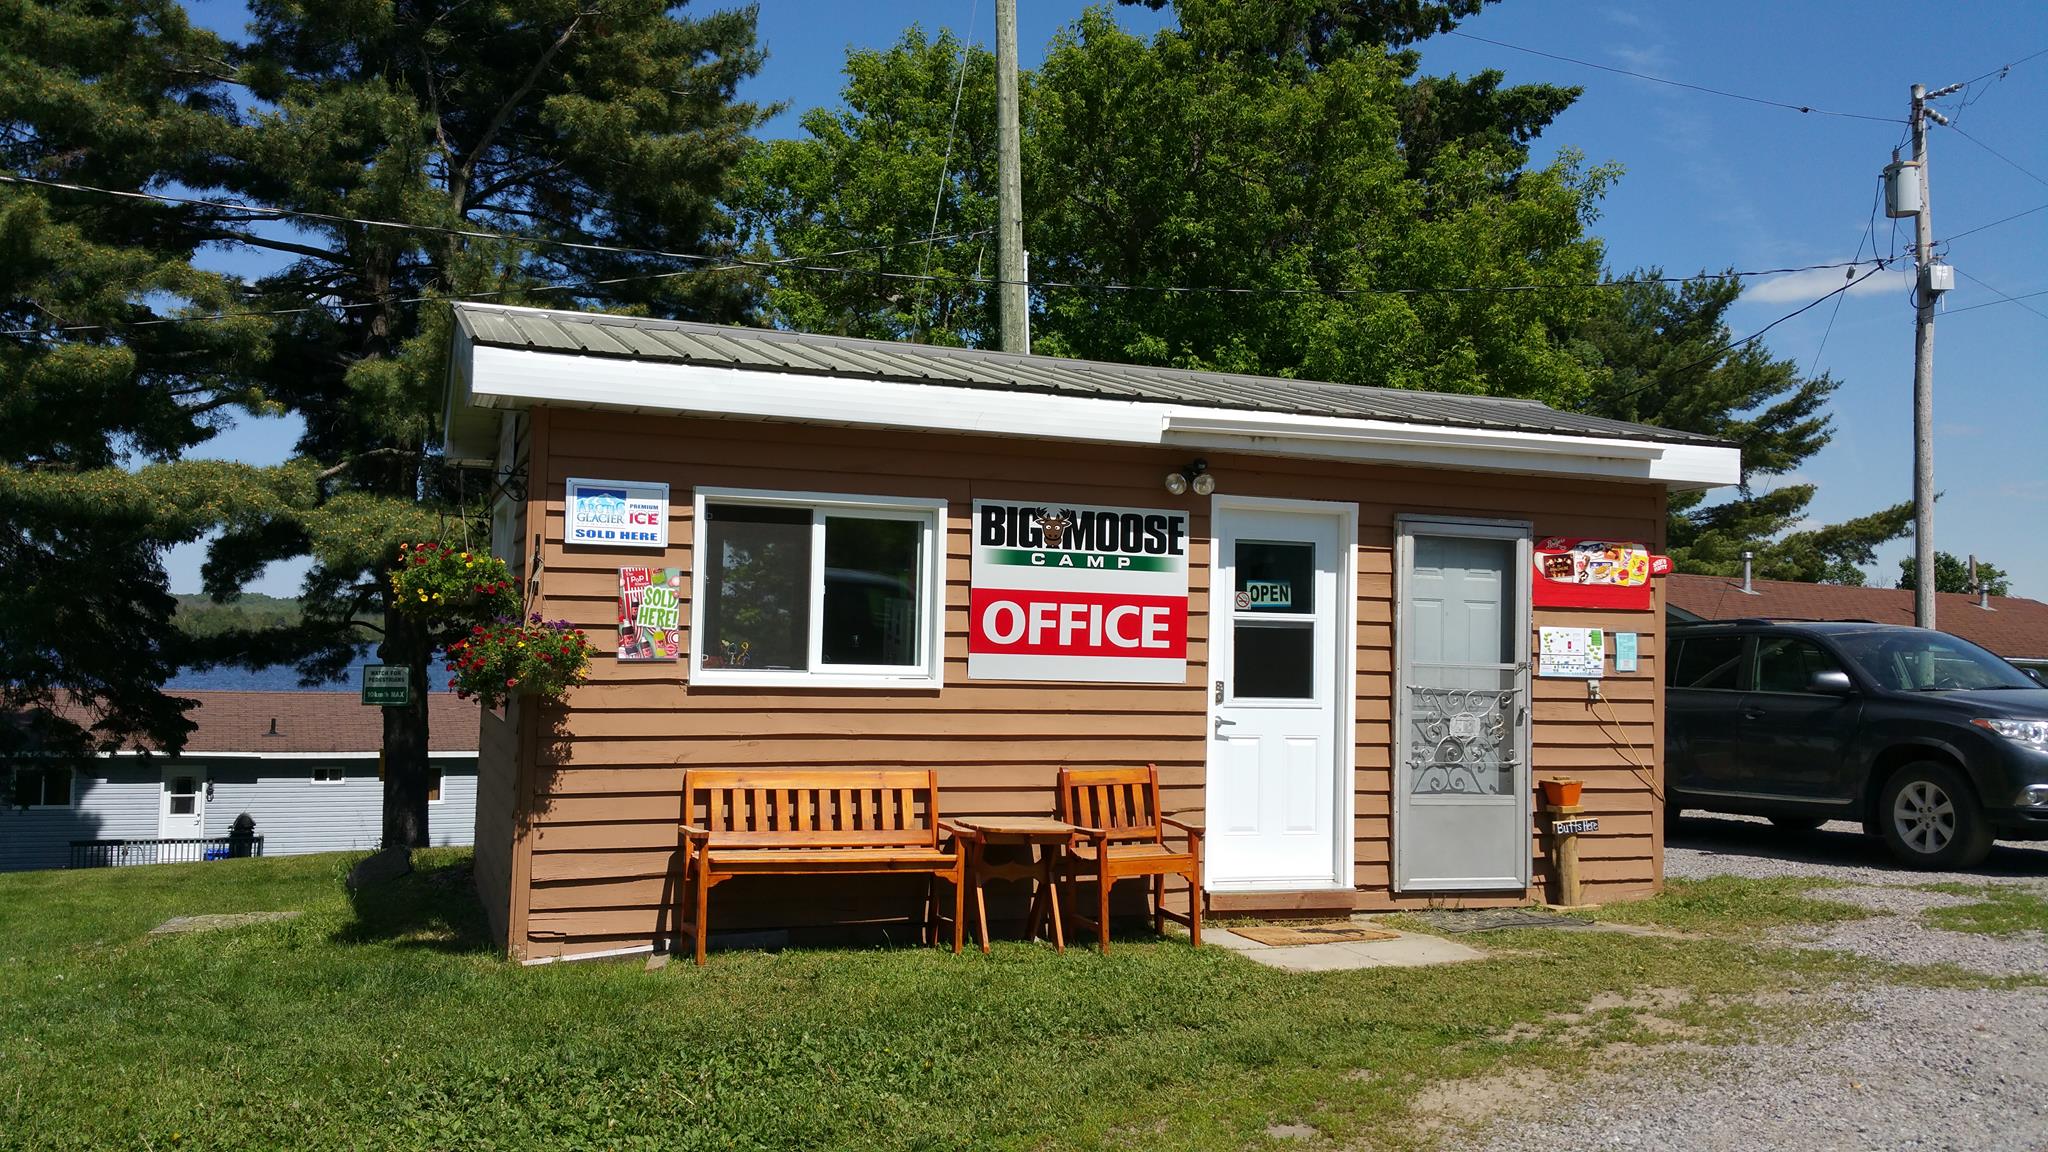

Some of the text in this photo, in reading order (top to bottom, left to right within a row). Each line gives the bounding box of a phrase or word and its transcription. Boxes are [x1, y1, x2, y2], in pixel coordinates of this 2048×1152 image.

[629, 503, 659, 511] PREMIUM
[576, 512, 625, 525] GLACIER
[628, 510, 660, 526] ICE
[575, 529, 658, 541] SOLD HERE
[980, 505, 1185, 556] BIG MOOSE
[1031, 552, 1131, 569] CAMP
[644, 586, 677, 608] SOLD
[1250, 584, 1289, 602] OPEN
[638, 606, 679, 629] HERE!
[982, 600, 1171, 649] OFFICE
[1556, 820, 1583, 834] Butts
